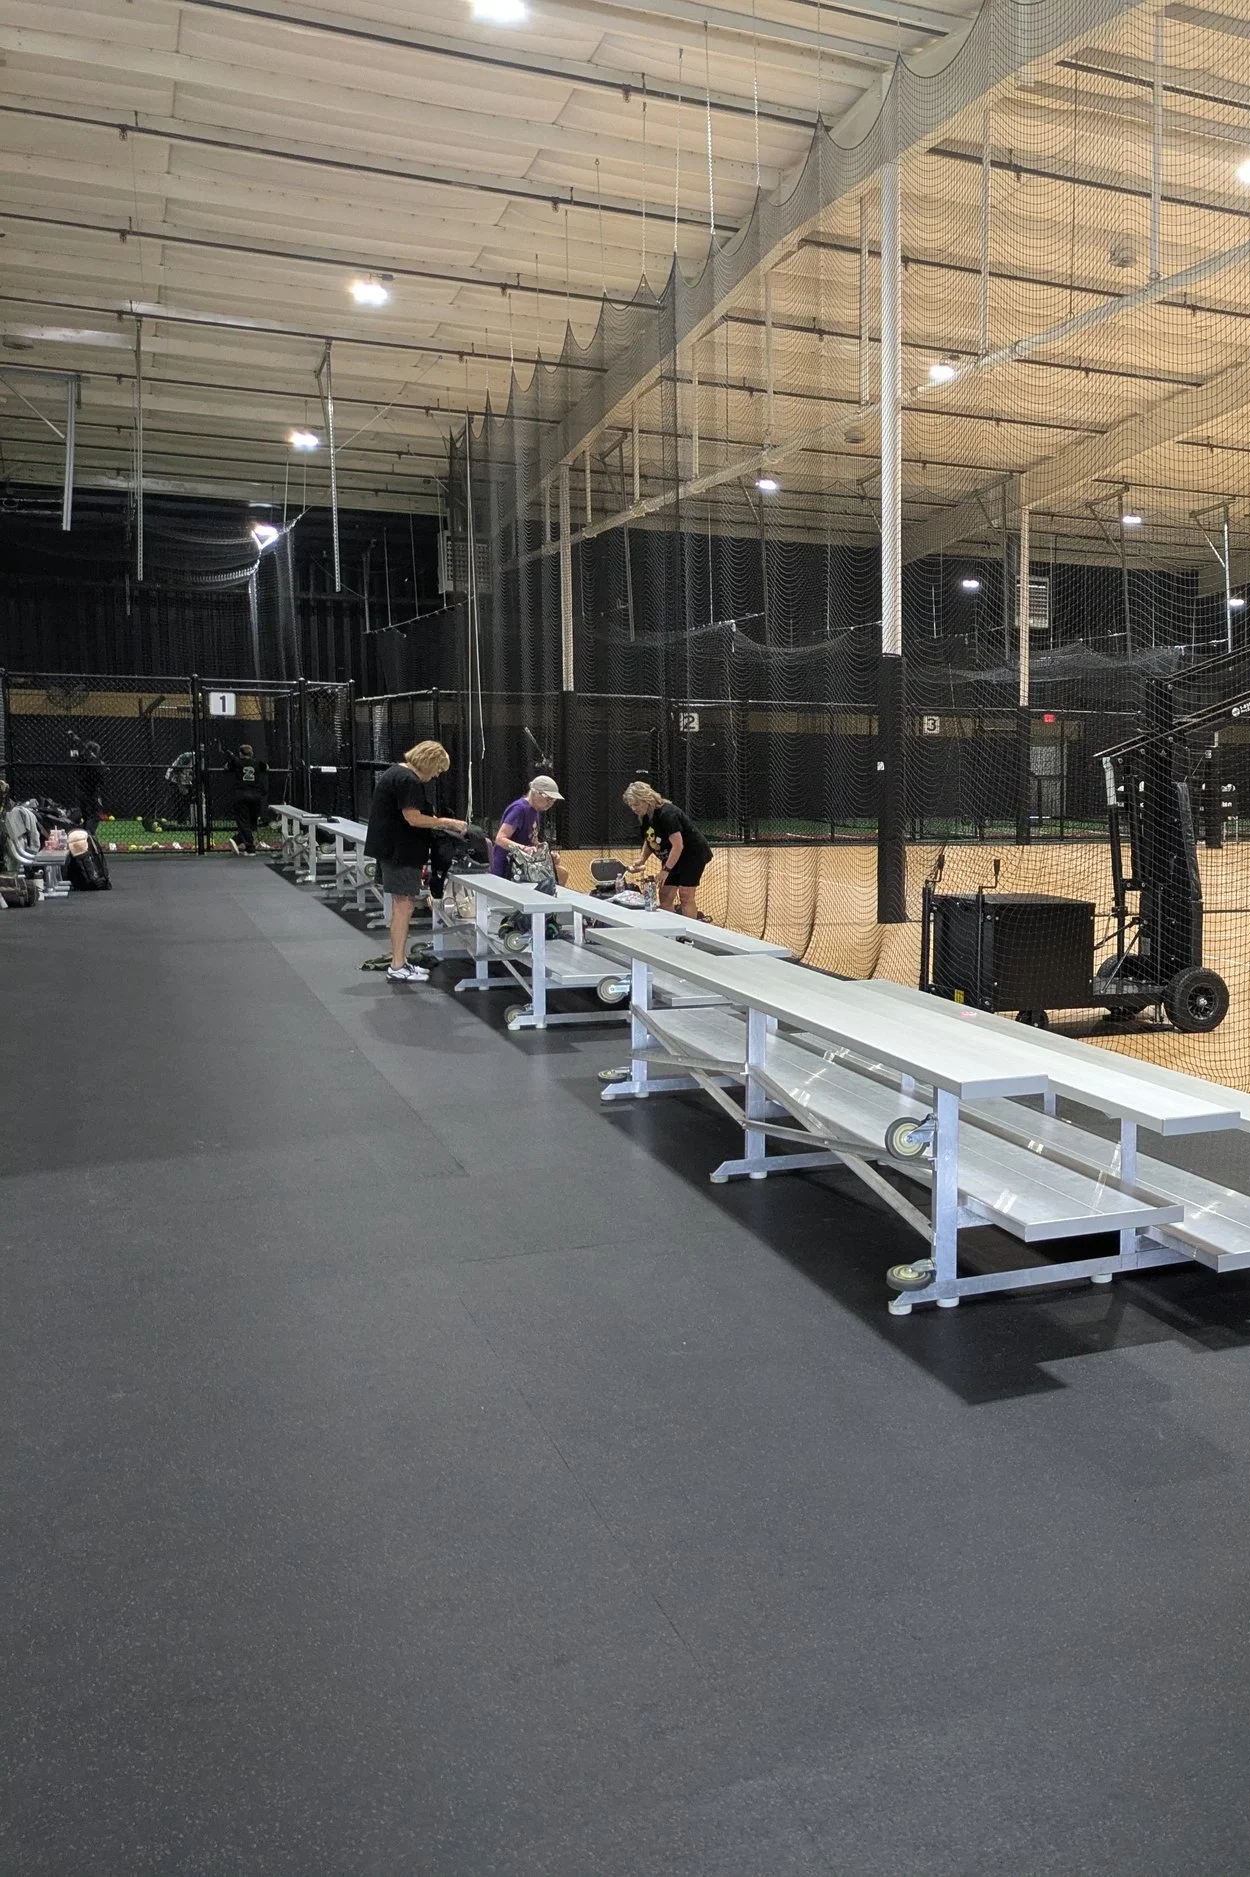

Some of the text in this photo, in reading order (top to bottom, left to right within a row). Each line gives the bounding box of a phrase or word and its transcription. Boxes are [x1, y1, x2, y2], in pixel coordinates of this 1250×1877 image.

[219, 695, 227, 713] 1
[683, 715, 696, 730] 2
[926, 717, 937, 732] 3
[242, 766, 256, 781] 2
